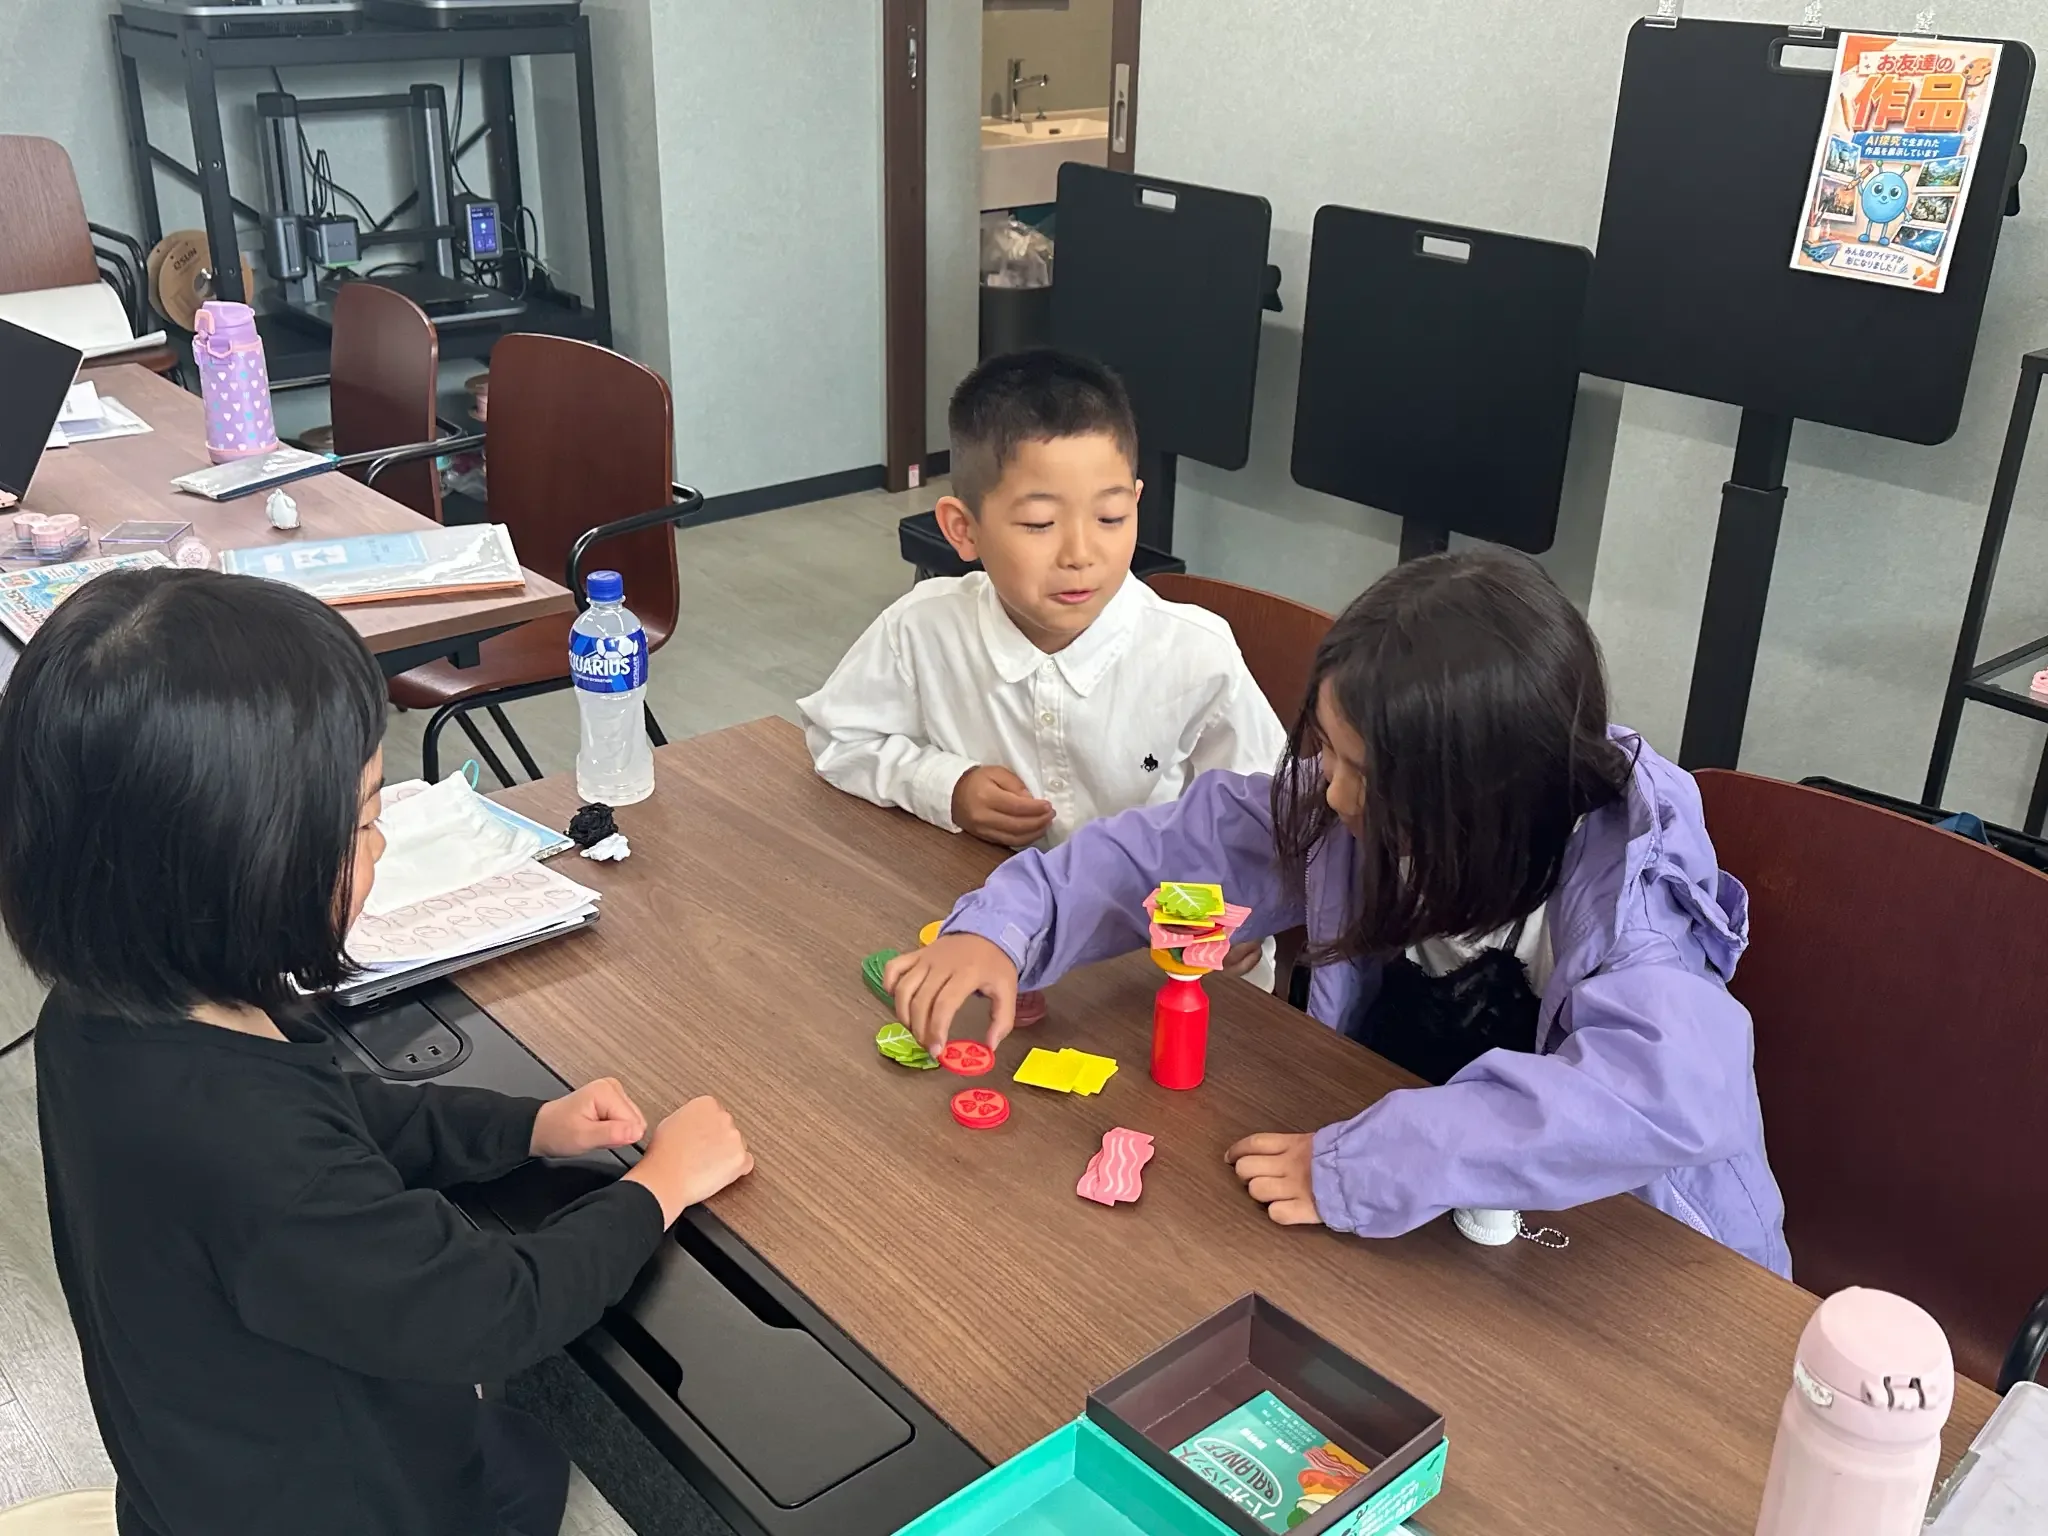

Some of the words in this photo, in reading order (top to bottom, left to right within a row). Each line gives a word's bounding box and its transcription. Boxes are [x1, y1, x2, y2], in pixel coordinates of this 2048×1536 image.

[1877, 54, 1955, 72] お友達の
[1853, 74, 1968, 132] 作品
[569, 651, 630, 676] QUARIUS
